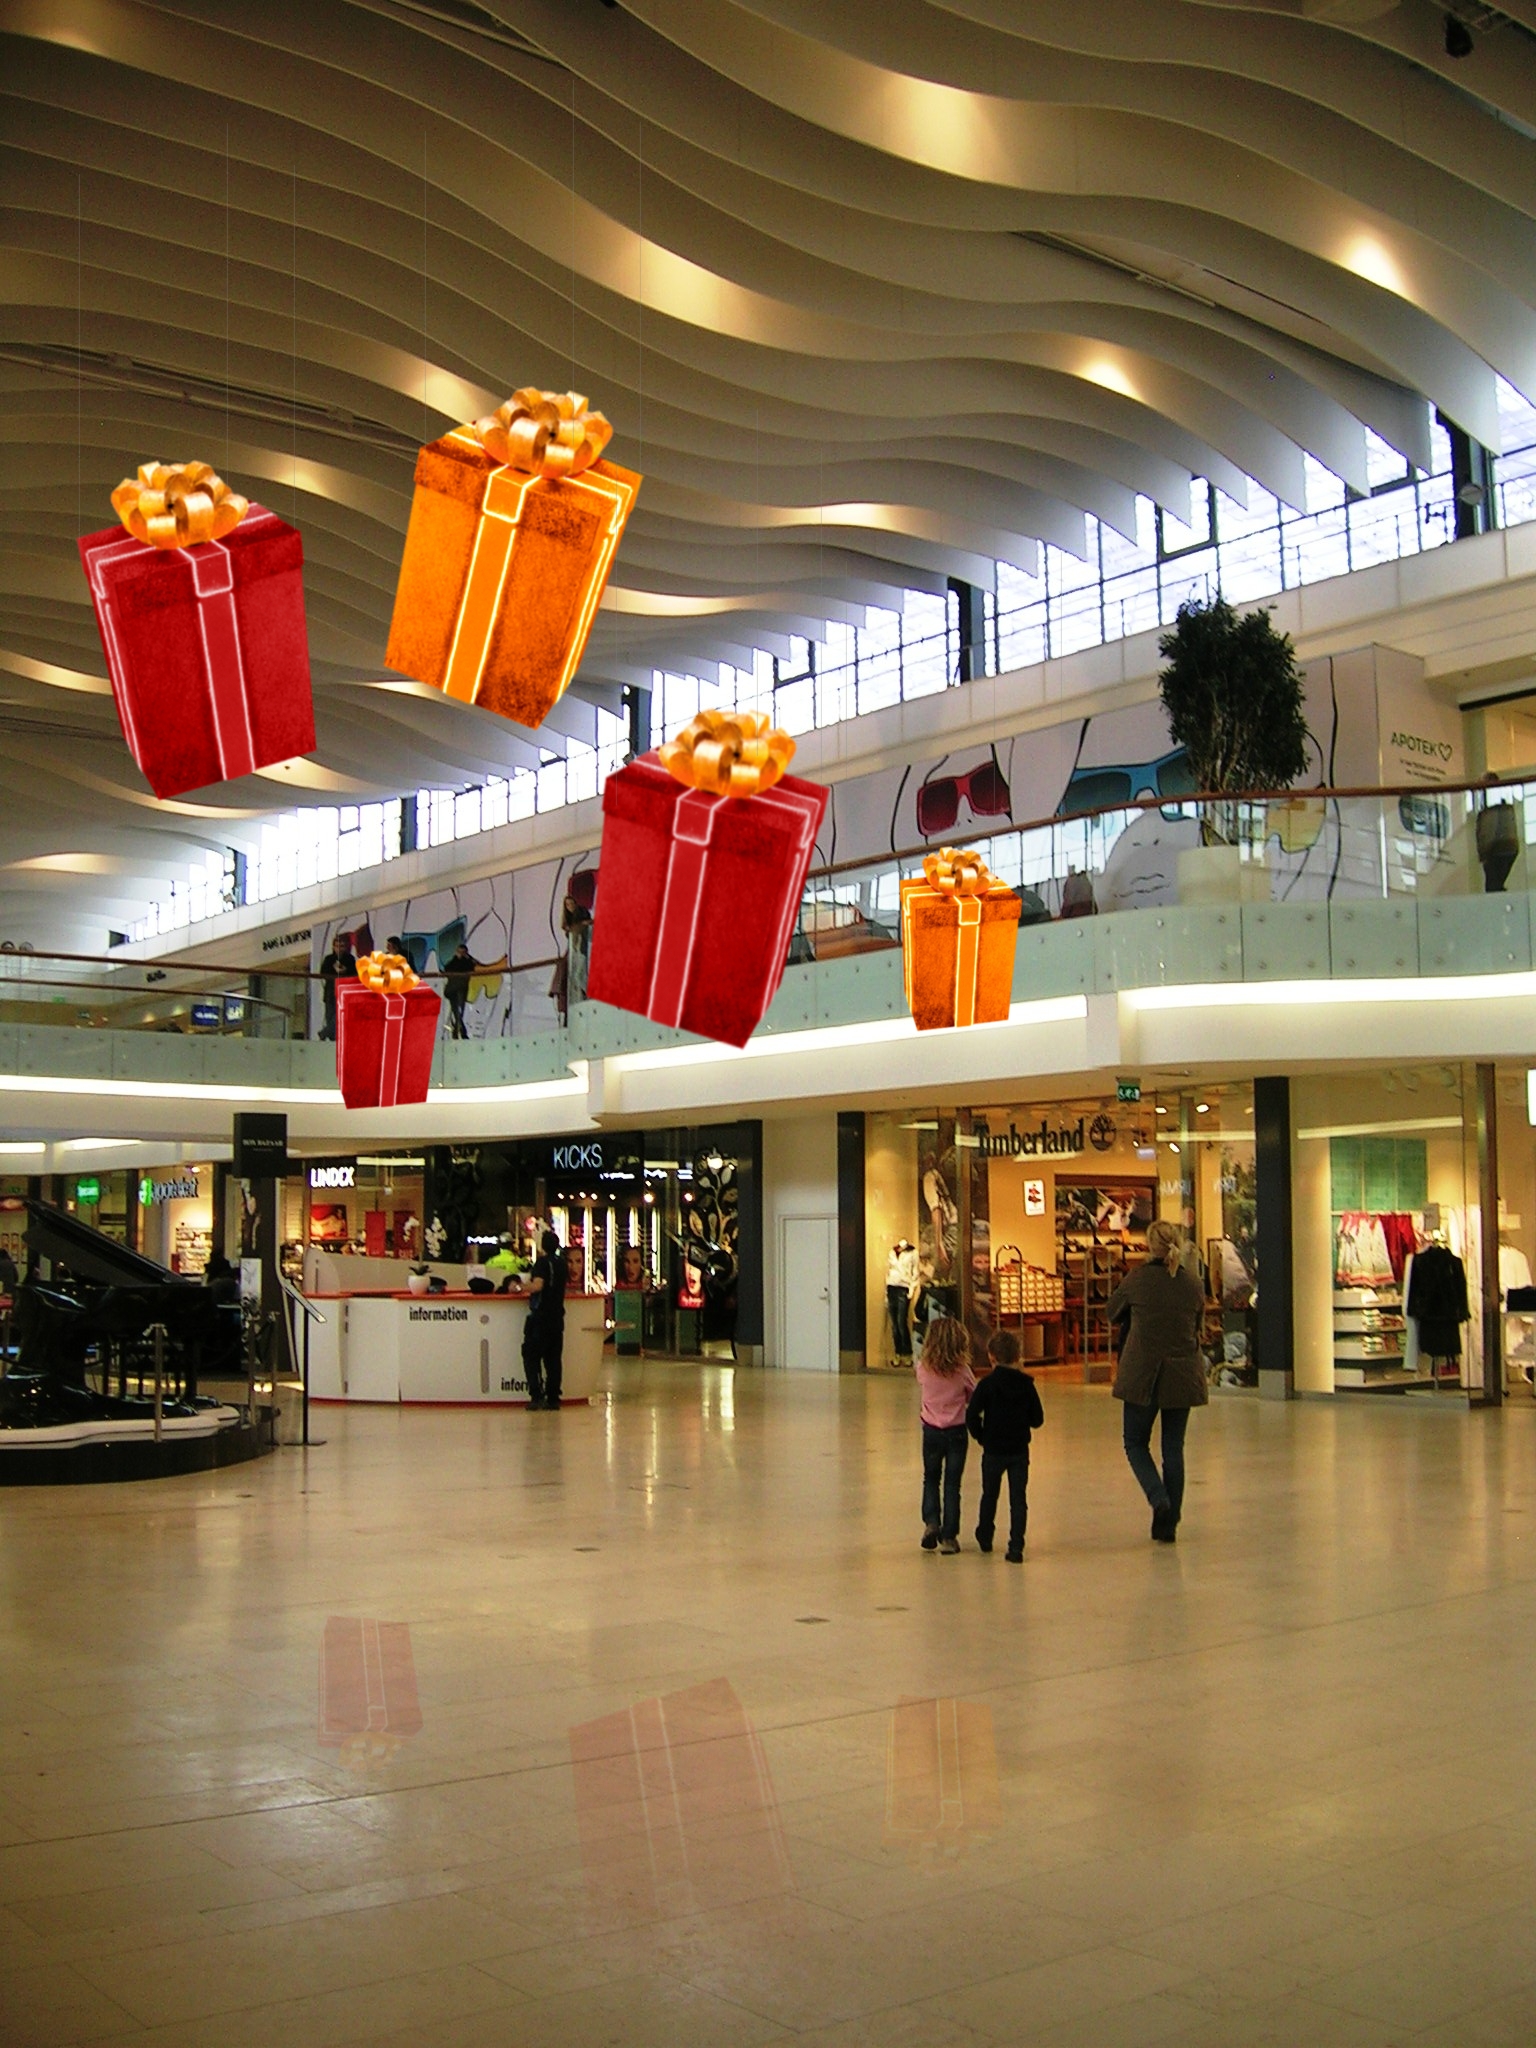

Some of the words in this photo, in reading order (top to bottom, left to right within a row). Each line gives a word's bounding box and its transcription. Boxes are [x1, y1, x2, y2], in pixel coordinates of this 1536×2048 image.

[1391, 732, 1438, 756] APOTEK
[974, 1116, 1085, 1158] Timberland
[553, 1143, 603, 1169] KICKS
[310, 1166, 355, 1188] LINDEX
[409, 1306, 468, 1321] information
